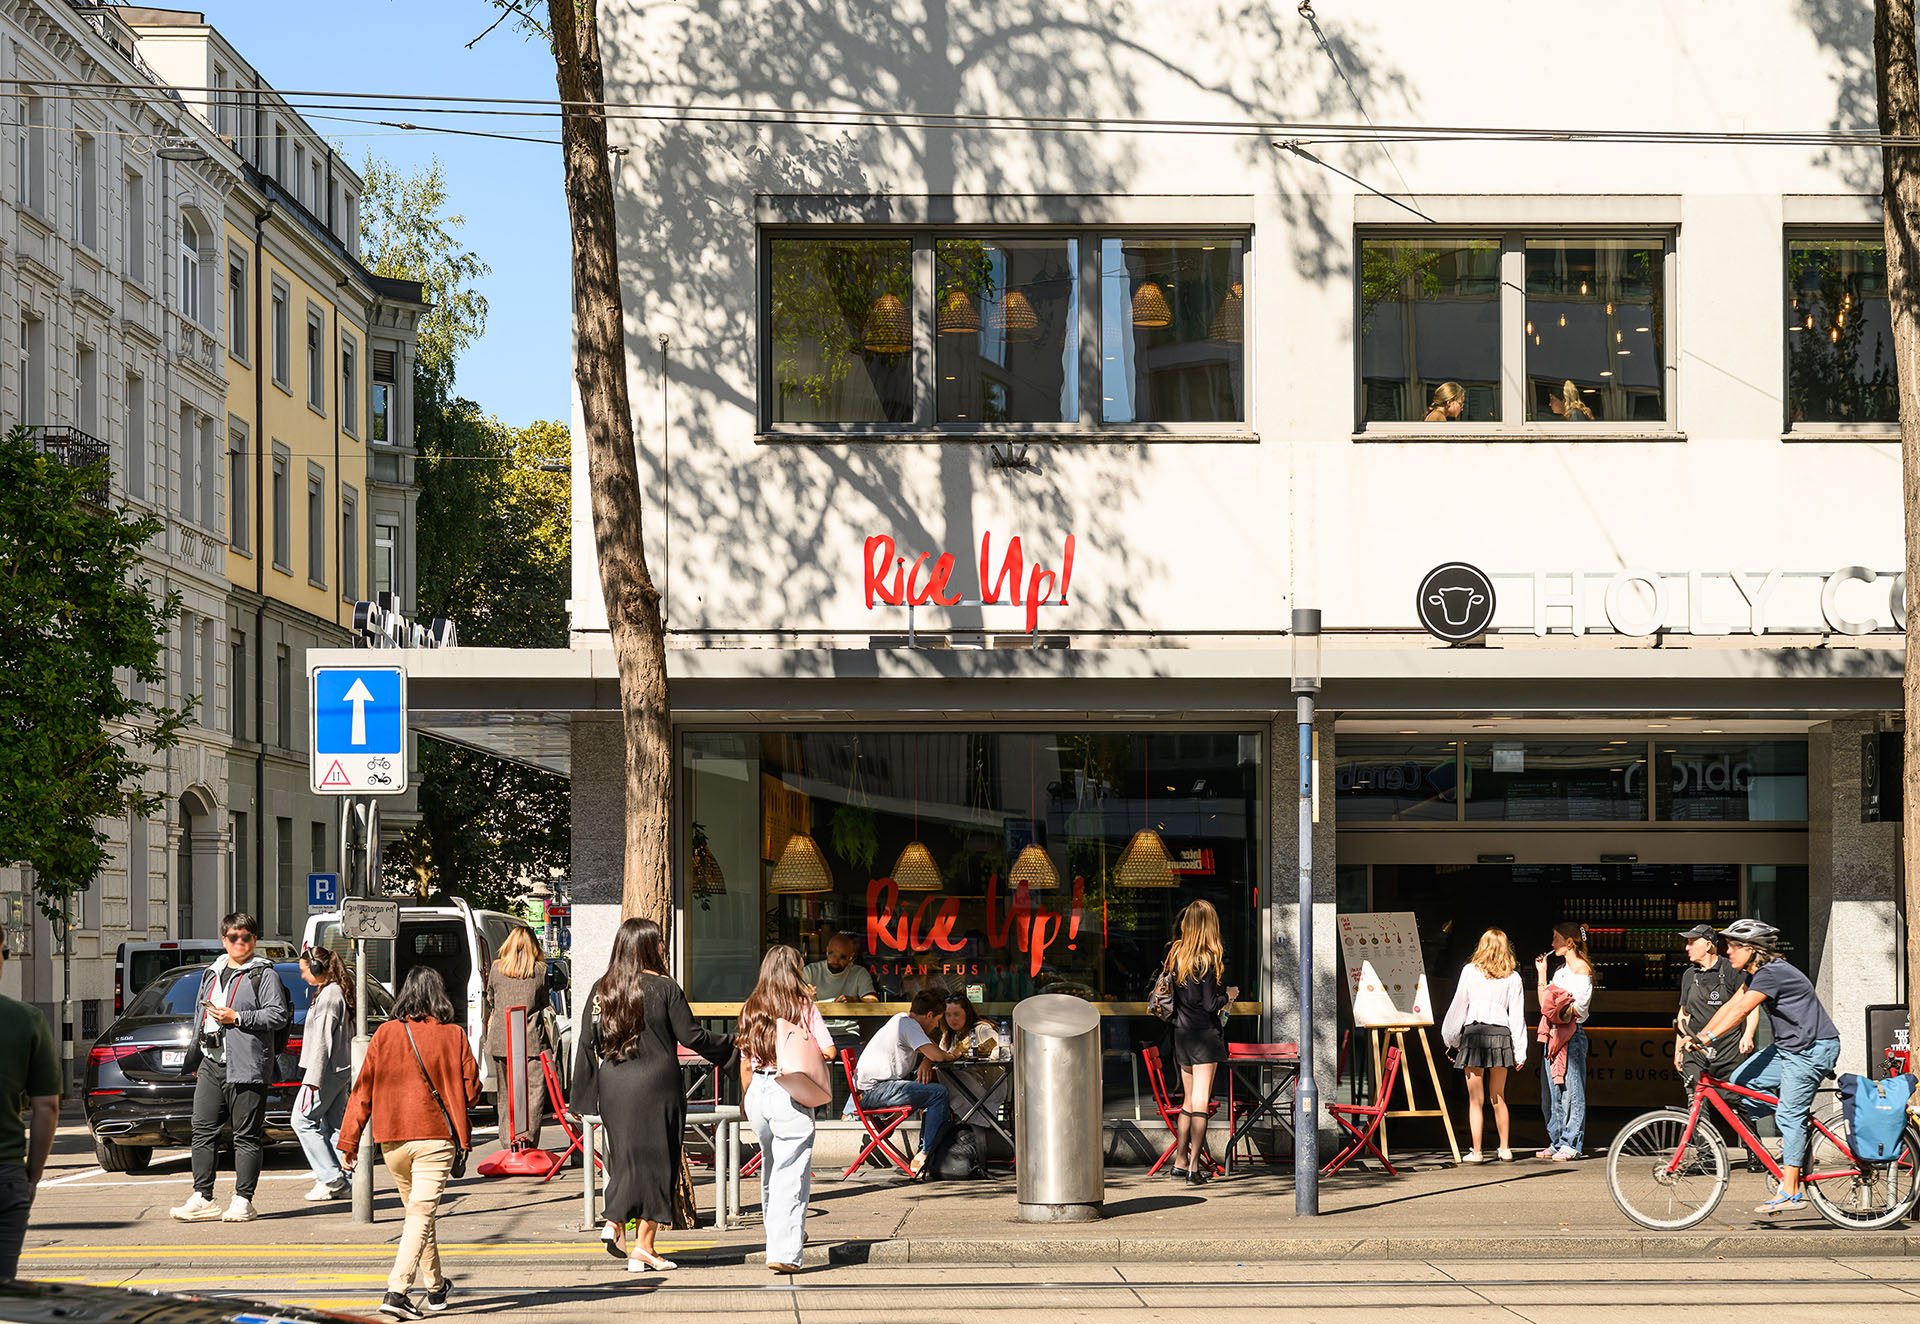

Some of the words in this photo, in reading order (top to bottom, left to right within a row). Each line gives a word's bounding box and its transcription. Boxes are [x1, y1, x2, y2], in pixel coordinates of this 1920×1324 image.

[864, 534, 962, 609] Rice
[980, 530, 1076, 634] Up!
[1534, 566, 1783, 637] HOLY
[316, 879, 329, 900] P
[866, 877, 967, 956] Rice
[987, 873, 1085, 977] Up!
[869, 964, 928, 976] ASIAN
[943, 964, 1019, 976] FUSION
